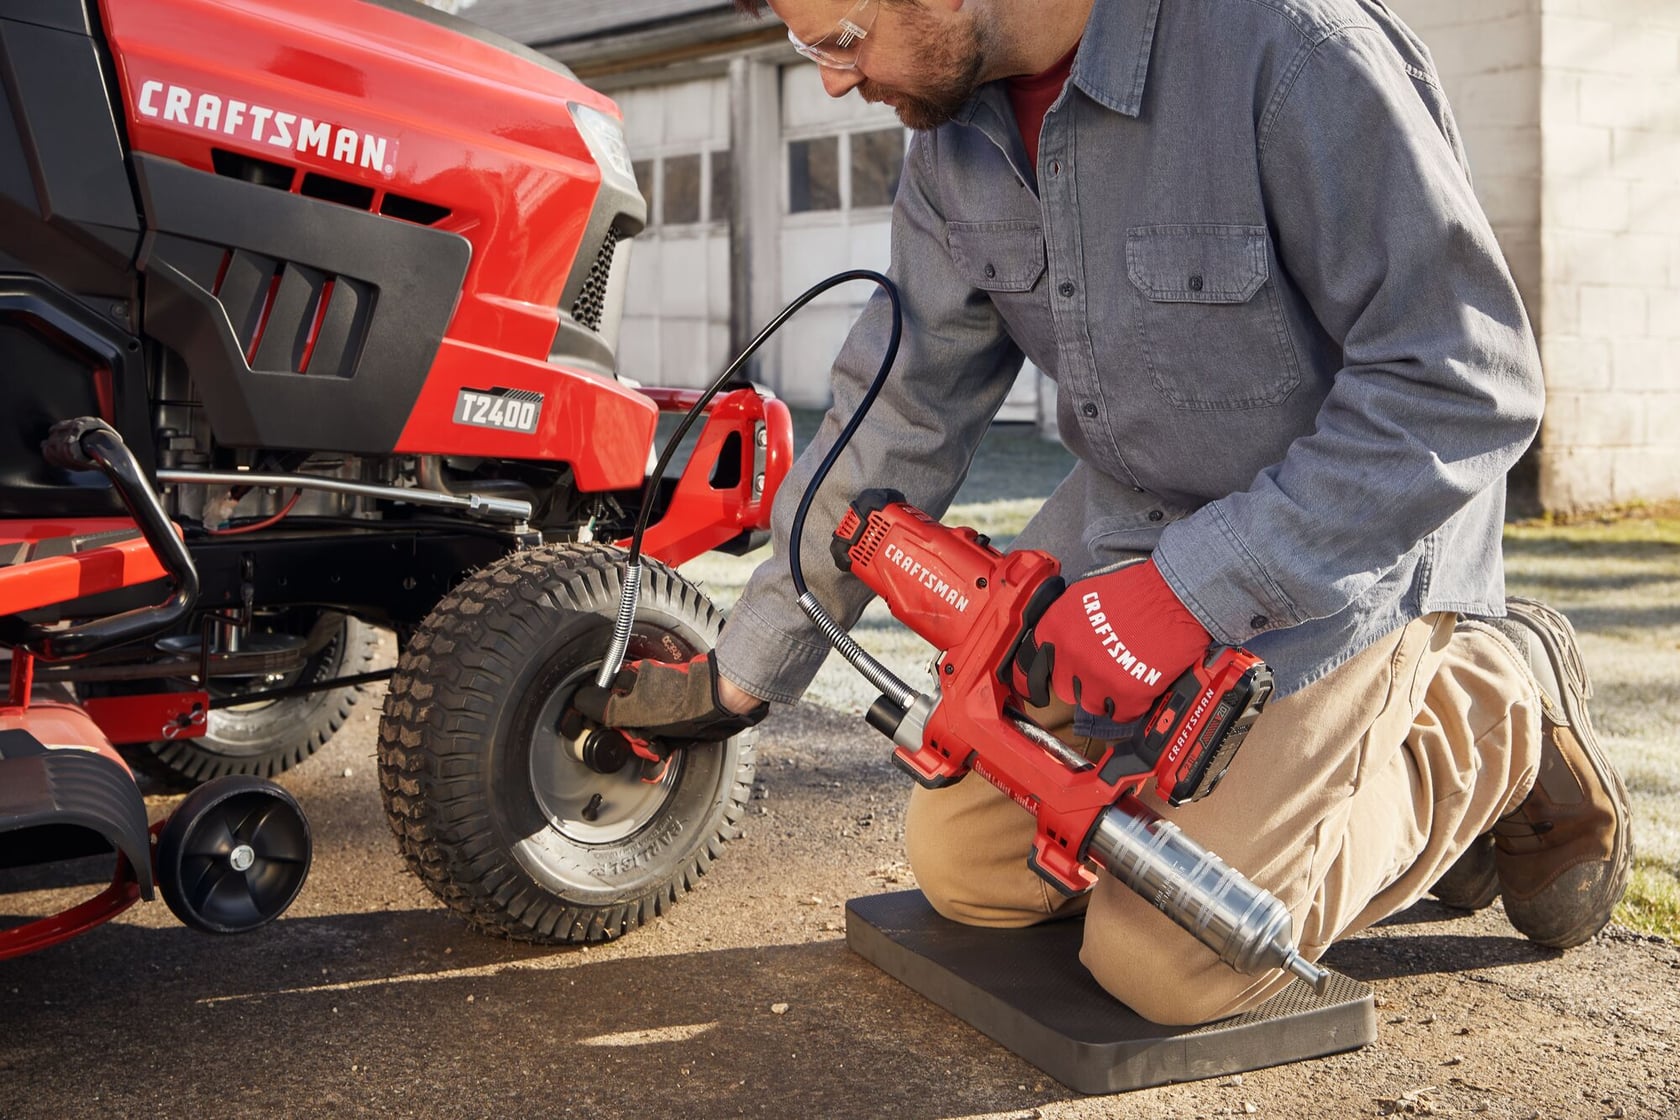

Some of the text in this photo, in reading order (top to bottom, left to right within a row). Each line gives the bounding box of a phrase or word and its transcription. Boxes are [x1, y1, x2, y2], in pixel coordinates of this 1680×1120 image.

[138, 80, 387, 171] CRAFTSMAN
[462, 393, 536, 430] T2400
[884, 543, 969, 612] CRAFTSMAN
[1082, 591, 1162, 686] CRAFTSMAN
[1168, 688, 1214, 762] CRAFTSMAN
